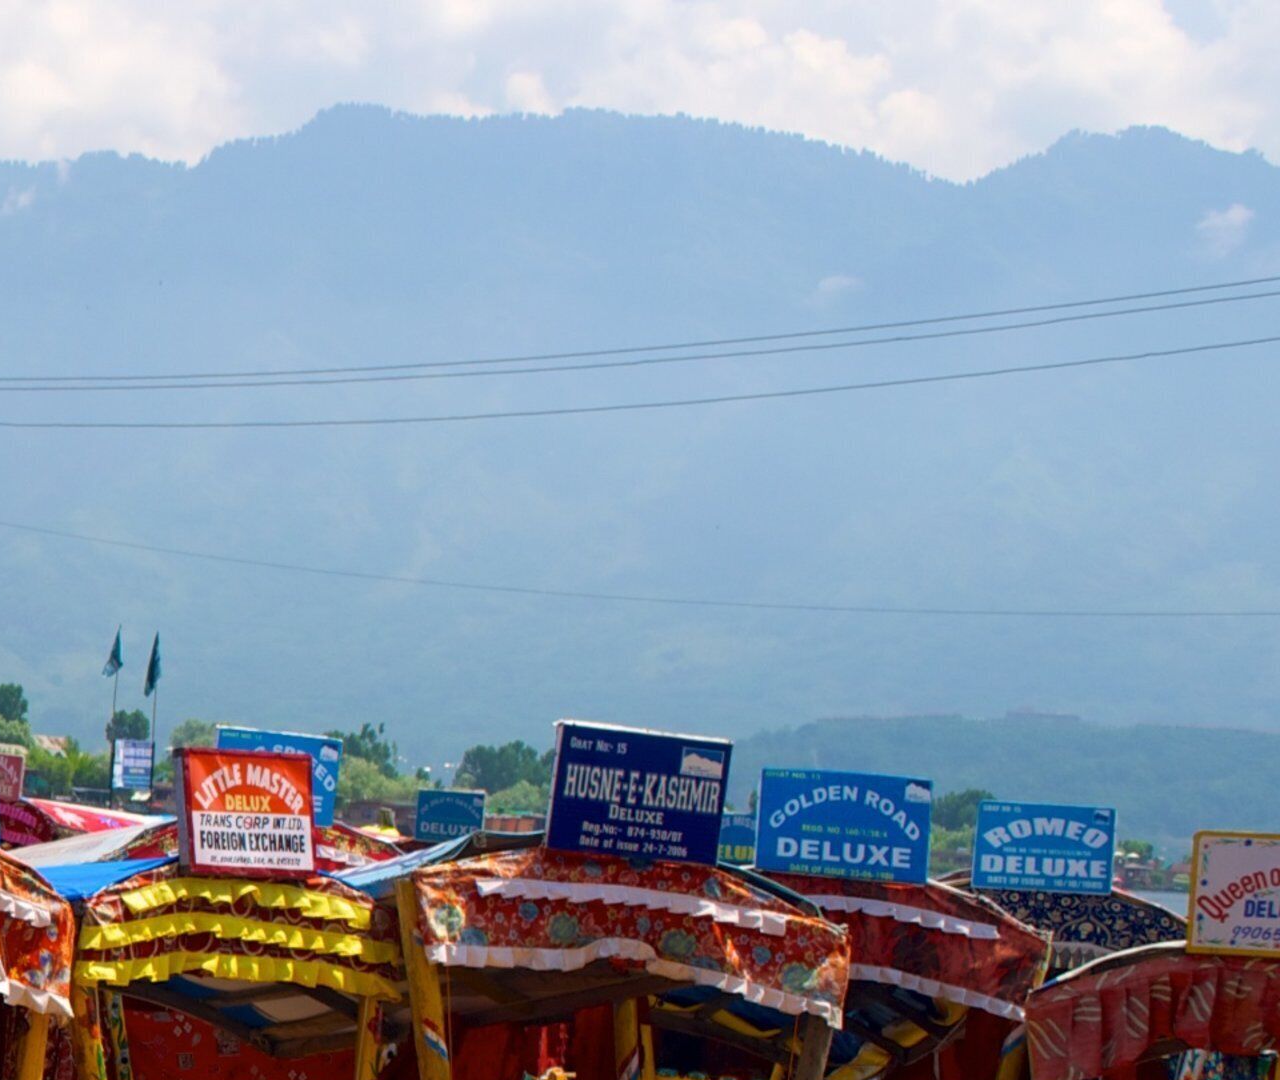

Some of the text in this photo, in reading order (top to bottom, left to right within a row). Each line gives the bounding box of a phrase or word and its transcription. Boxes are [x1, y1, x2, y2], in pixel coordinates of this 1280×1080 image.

[617, 742, 628, 755] 15
[194, 762, 304, 815] LITTLE MASTER
[563, 763, 721, 815] HUSNE-E-KASHMIR
[225, 794, 272, 812] DELUX
[609, 804, 665, 825] DELUXE
[769, 785, 921, 841] GOLDEN ROAD
[200, 813, 232, 828] TRANS
[235, 816, 269, 830] CORP
[983, 817, 1109, 849] ROMEO
[199, 831, 306, 854] FOREIGN EXCHANGE
[579, 834, 600, 848] Date
[603, 838, 614, 849] of
[776, 837, 912, 869] DELUXE
[980, 854, 1107, 879] DELUXE
[1197, 871, 1269, 924] Queen
[1244, 900, 1280, 919] DEL
